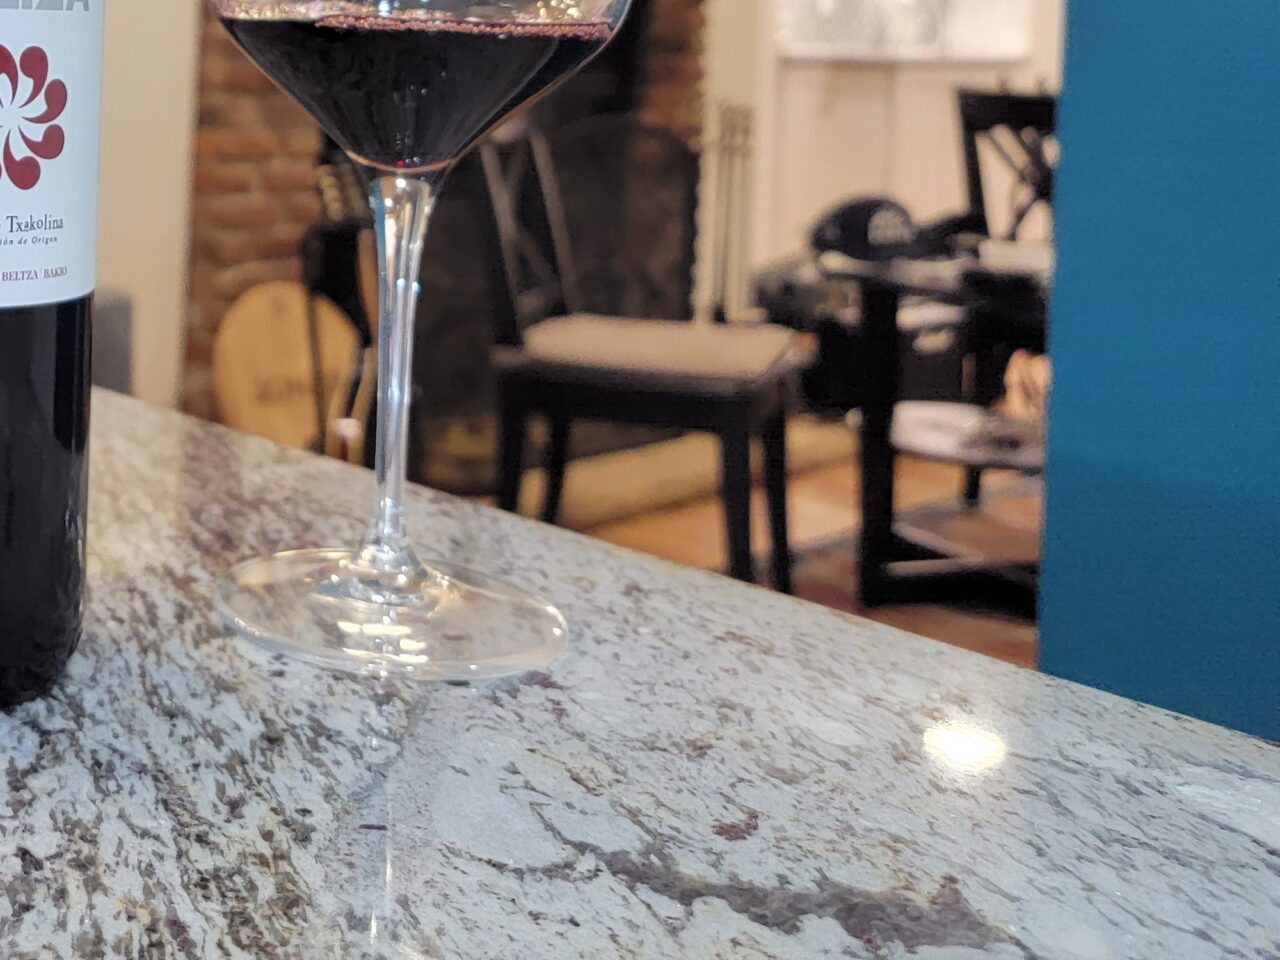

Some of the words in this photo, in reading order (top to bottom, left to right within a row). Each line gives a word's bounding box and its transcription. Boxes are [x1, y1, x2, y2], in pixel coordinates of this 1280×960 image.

[6, 213, 64, 233] Txakolina
[17, 237, 28, 245] de
[31, 235, 59, 245] Origen
[1, 270, 39, 281] BELTZA
[43, 266, 68, 279] BAKIO
